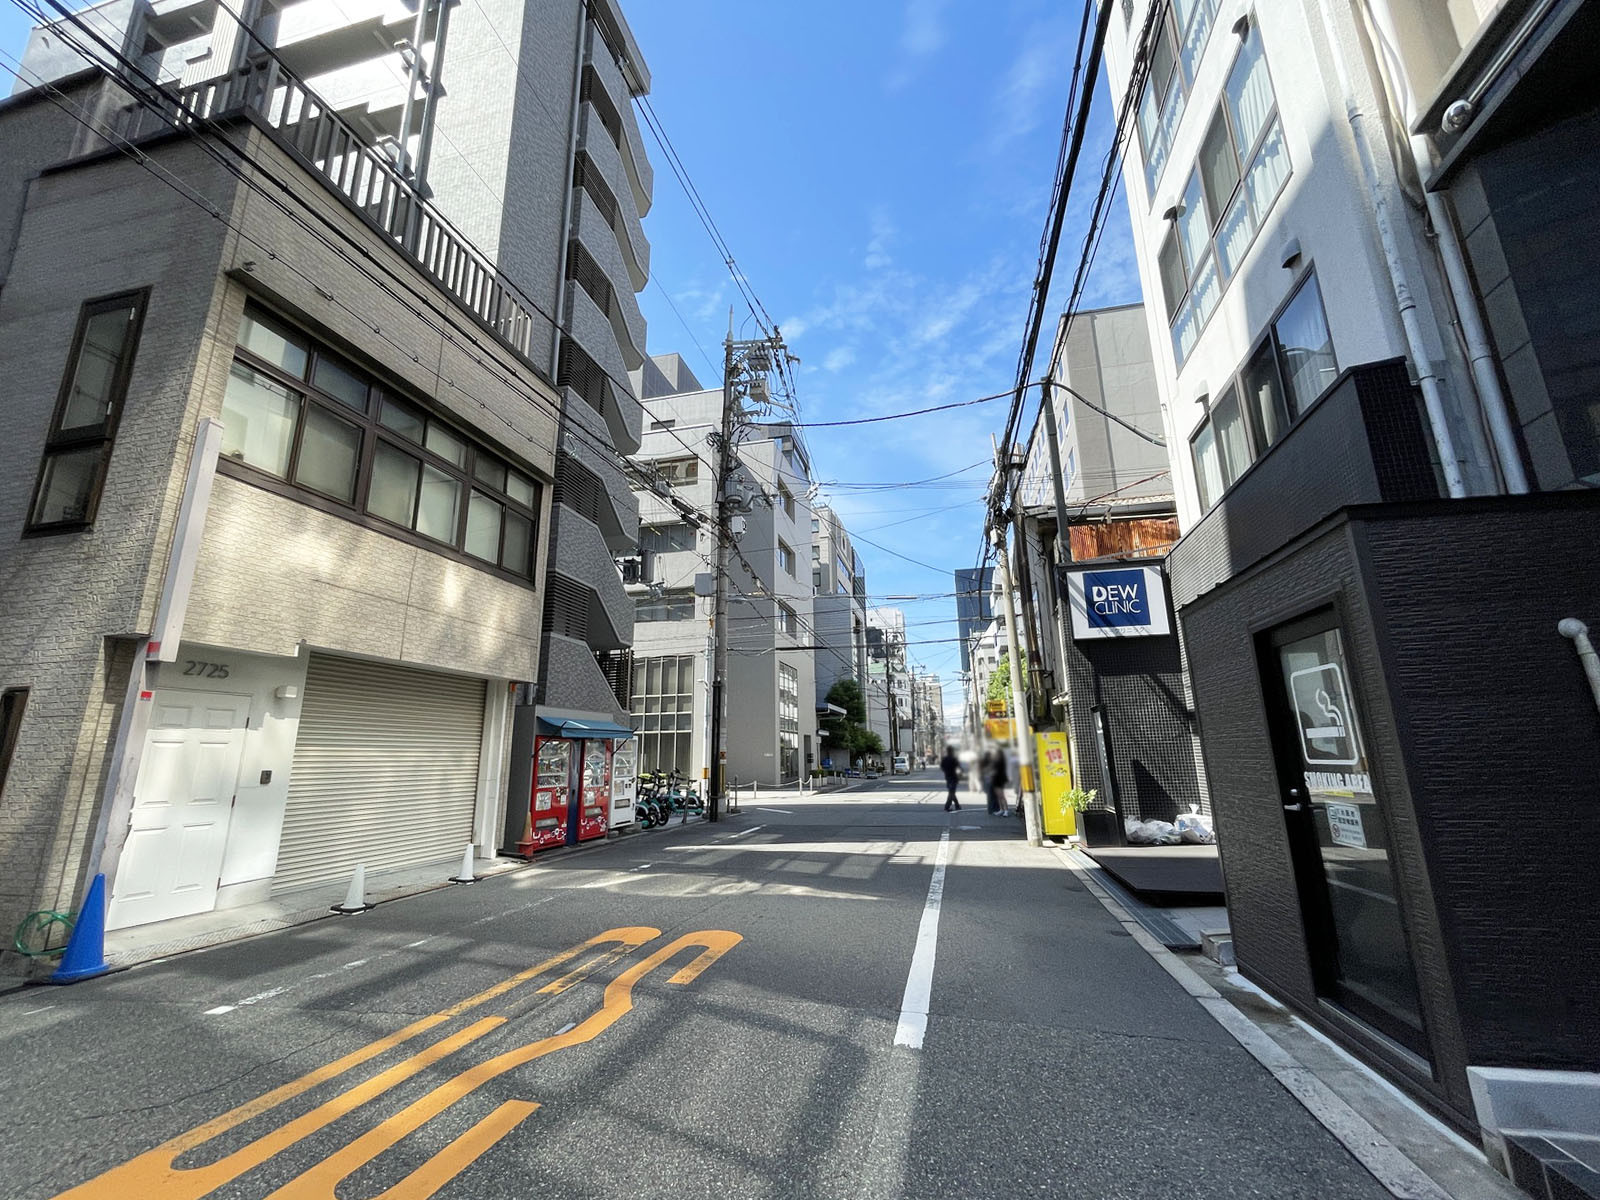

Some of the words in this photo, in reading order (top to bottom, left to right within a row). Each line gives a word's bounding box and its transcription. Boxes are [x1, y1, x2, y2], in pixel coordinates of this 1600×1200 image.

[1092, 583, 1138, 602] DEW
[1094, 599, 1142, 616] CLINIC
[183, 660, 229, 679] 2725
[1304, 771, 1345, 789] SMOKING
[1344, 772, 1373, 793] AREA
